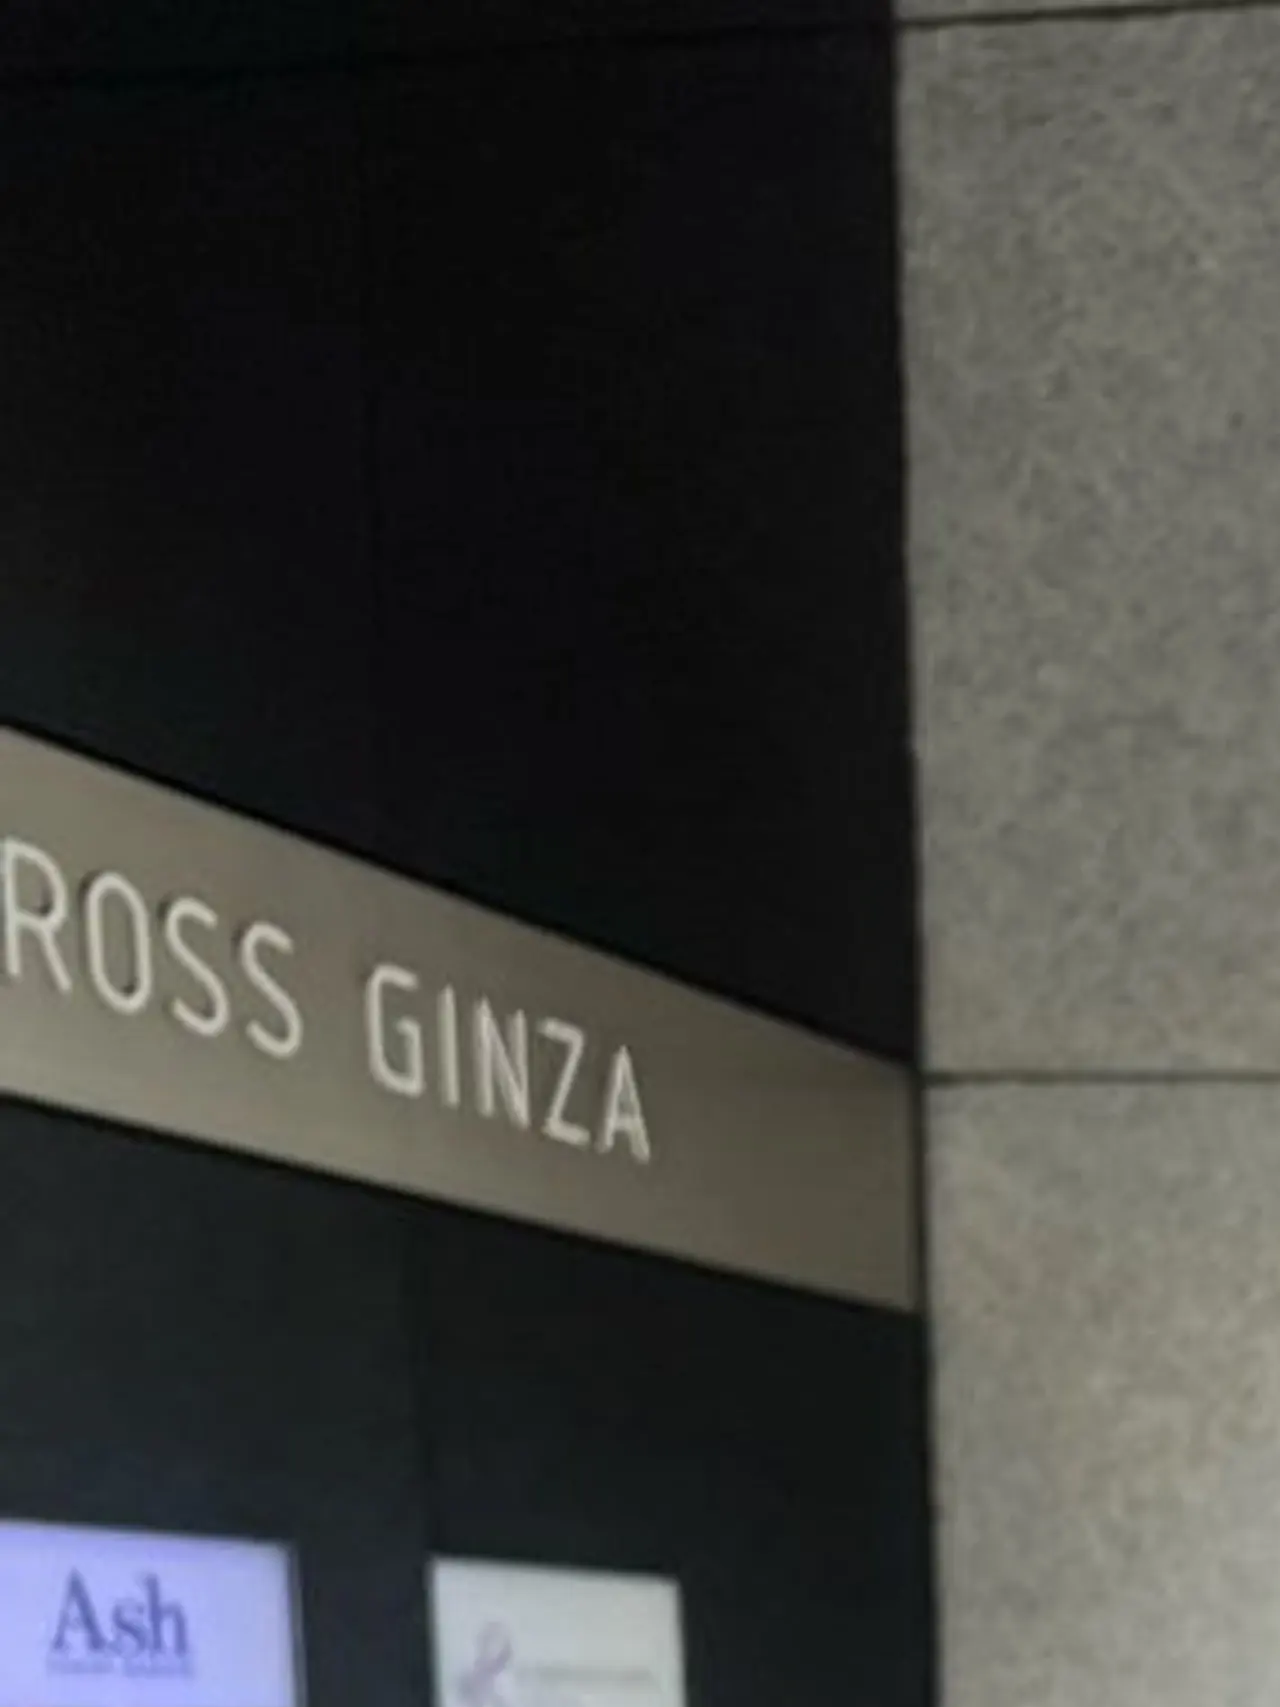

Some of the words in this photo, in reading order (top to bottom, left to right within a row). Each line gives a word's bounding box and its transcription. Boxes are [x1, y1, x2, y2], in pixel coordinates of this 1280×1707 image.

[0, 838, 302, 1058] ROSS
[367, 962, 650, 1163] GINZA
[51, 1566, 189, 1657] Ash
